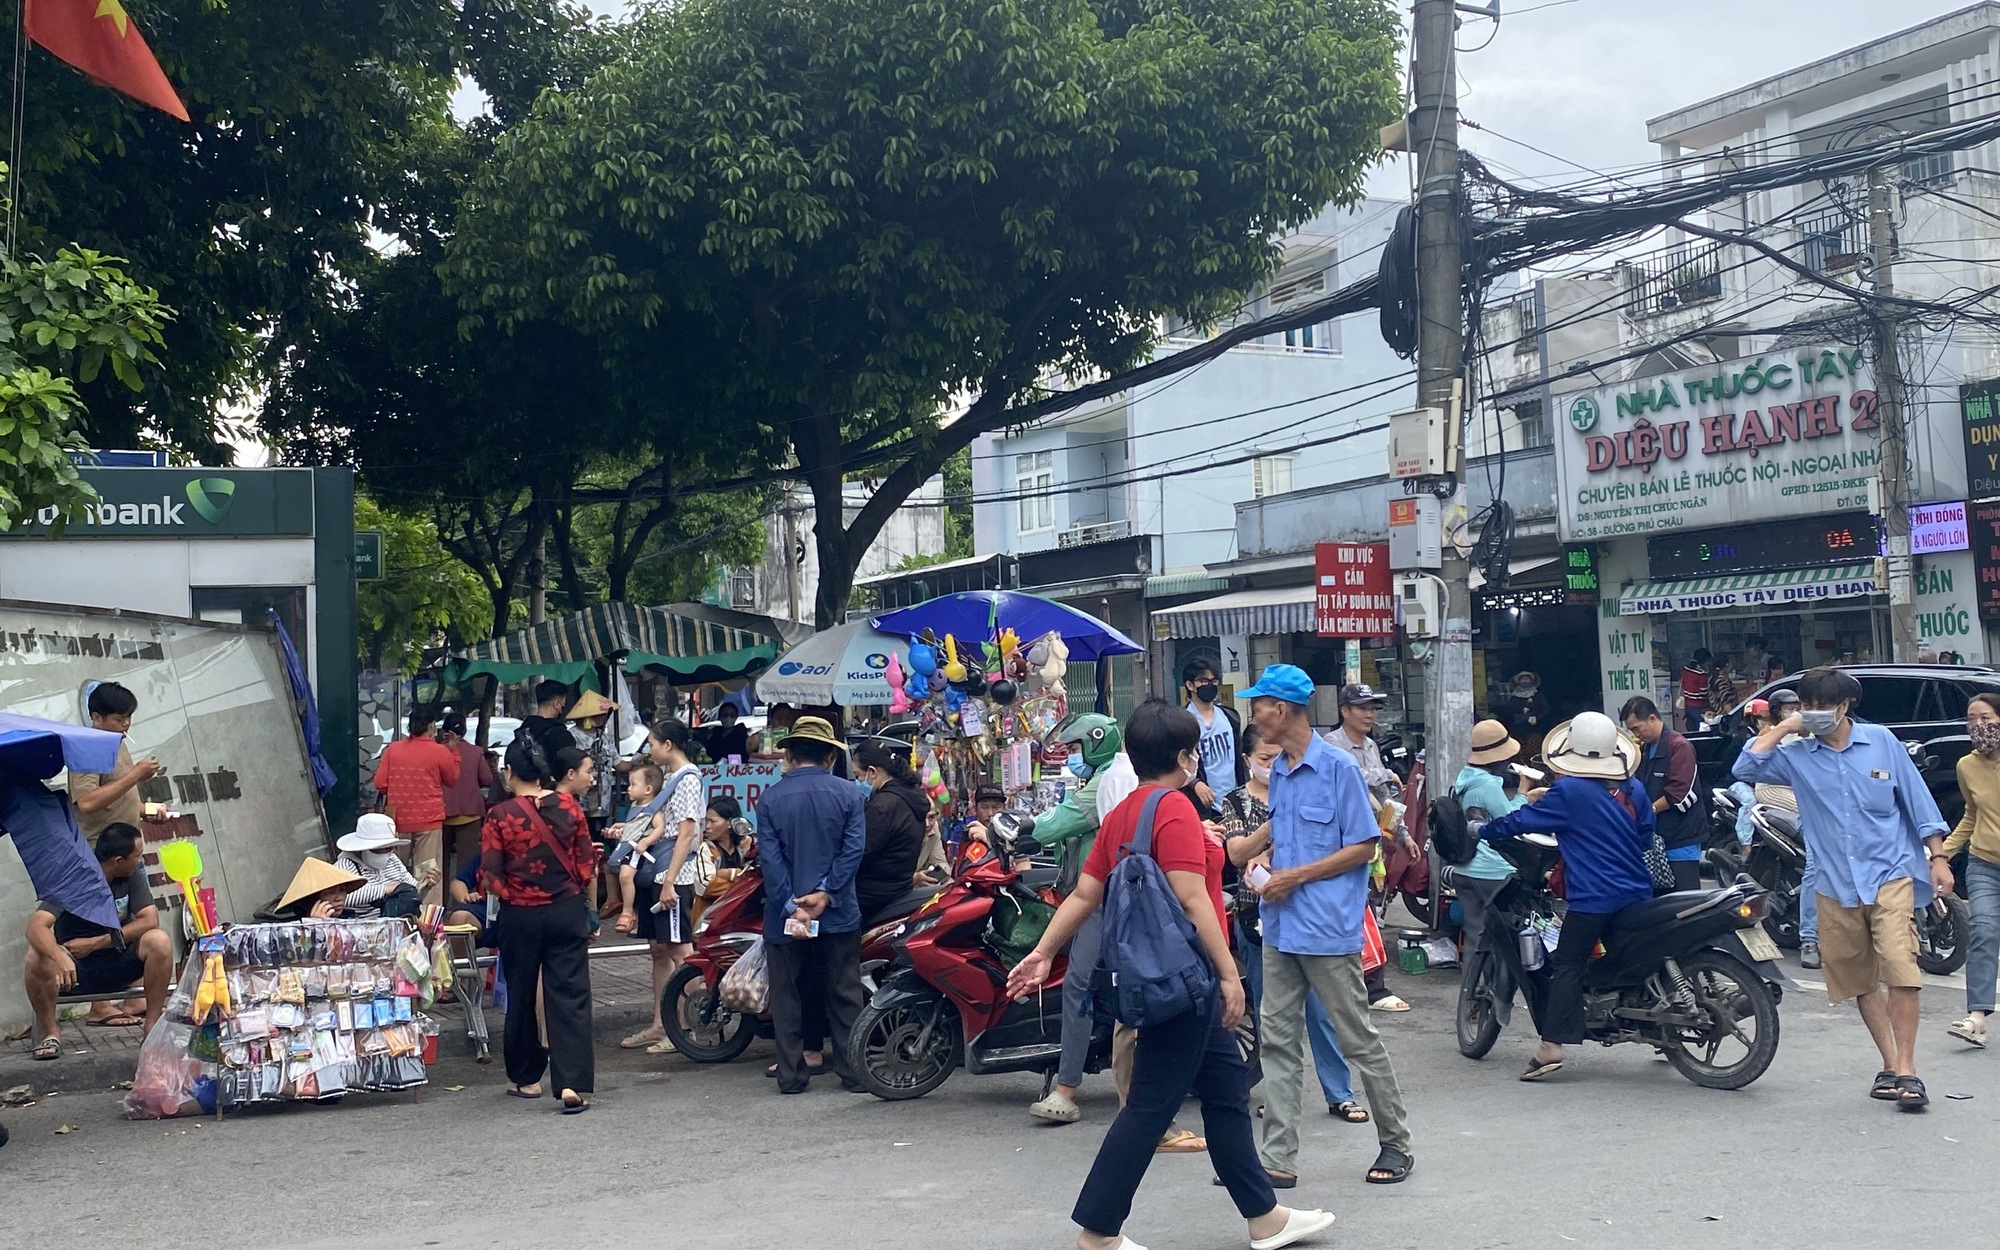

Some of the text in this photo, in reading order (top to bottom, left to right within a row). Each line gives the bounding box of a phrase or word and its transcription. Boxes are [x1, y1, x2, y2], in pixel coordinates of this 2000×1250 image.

[1616, 349, 1863, 417] NHÀ THUỐC TÂY
[1965, 390, 1993, 420] NHÀ
[1585, 389, 1881, 473] DIỆU HẠNH 2
[1971, 424, 2000, 446] DỤN
[1578, 482, 1635, 505] CHUYÊN
[1640, 476, 1669, 497] BÁN
[1674, 470, 1690, 492] LẺ
[1695, 462, 1747, 489] THUỐC
[1753, 460, 1780, 483] NỘI
[1792, 453, 1846, 476] NGOẠI
[1653, 498, 1679, 513] CHÚC
[1915, 511, 1933, 525] NHI
[1338, 546, 1374, 567] KHU VỰC
[1568, 548, 1591, 567] NHÀ
[1344, 564, 1365, 585] CẤM
[1566, 569, 1597, 589] THUỐC
[1916, 565, 1954, 595] BÁN
[1317, 594, 1329, 612] TỤ
[1331, 591, 1347, 613] TẬP
[1349, 591, 1372, 610] BUÔN
[1637, 597, 1673, 611] NHÀ
[1742, 589, 1777, 603] TÂY
[1783, 585, 1829, 600] DIỆU
[1835, 581, 1878, 595] HẠN
[1337, 611, 1364, 633] CHIẾM
[1916, 603, 1969, 637] HUỐC
[1608, 628, 1645, 658] VẬT TƯ
[801, 662, 835, 676] aoi
[847, 671, 887, 680] KidsPl
[1608, 663, 1650, 692] THIẾT BỊ
